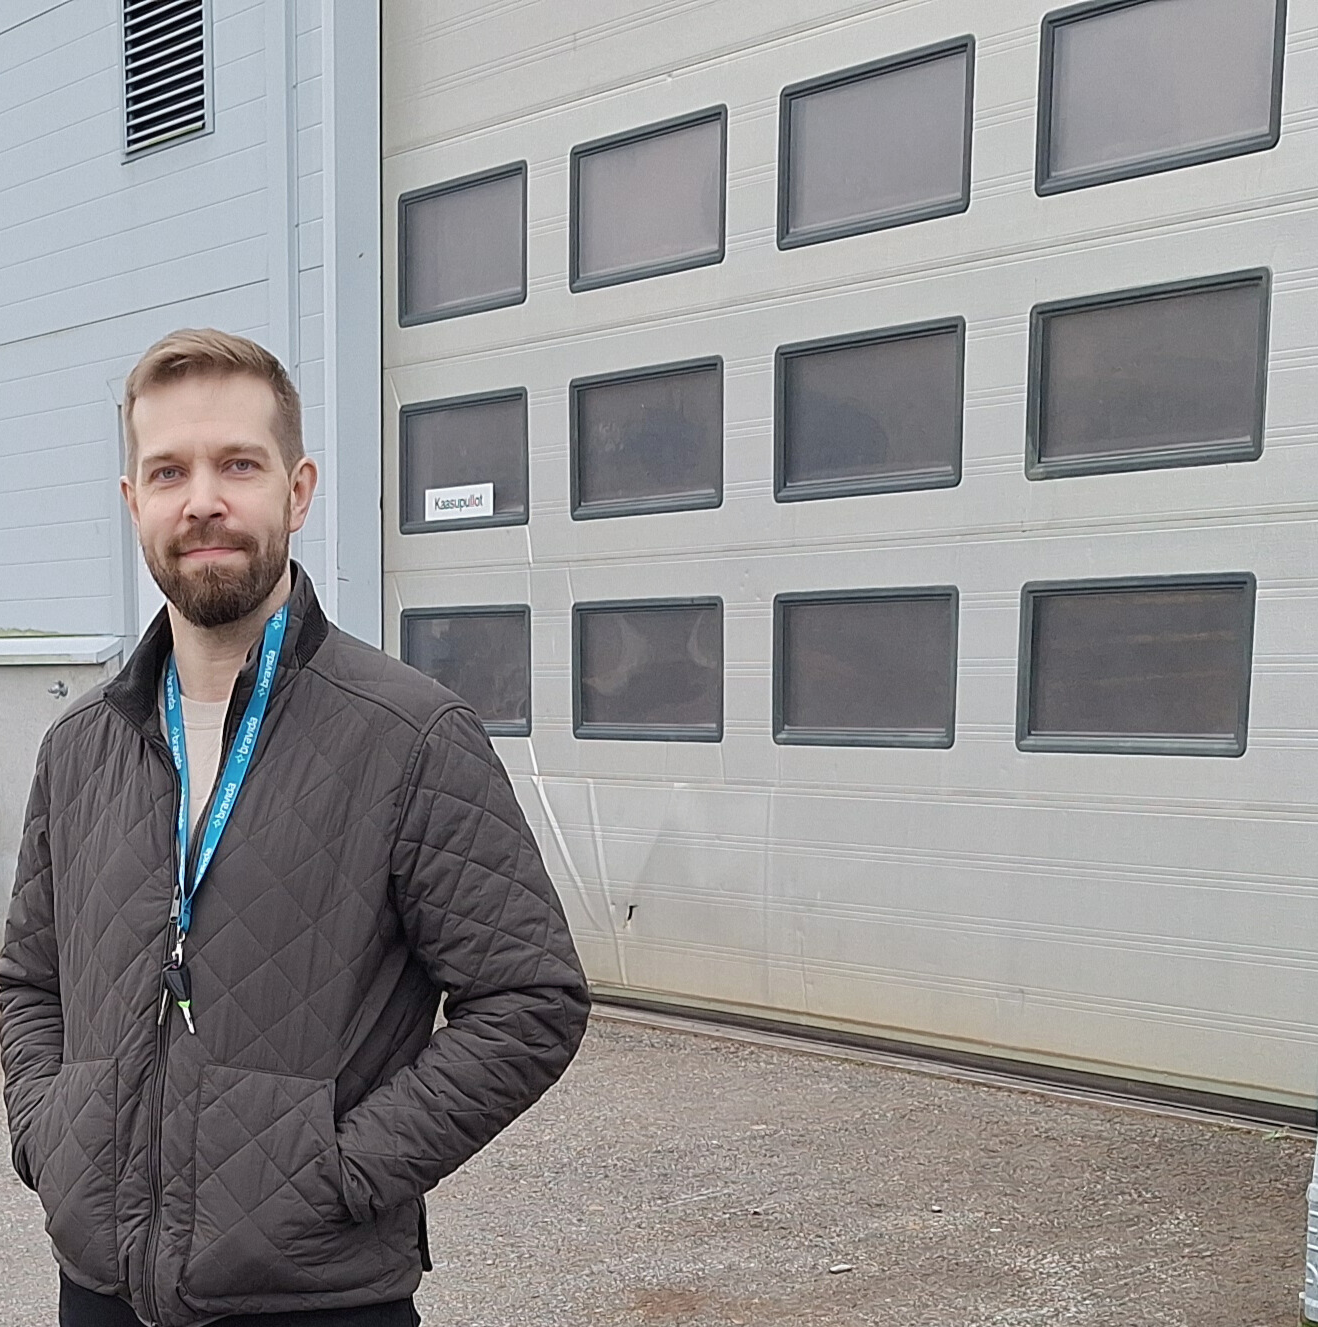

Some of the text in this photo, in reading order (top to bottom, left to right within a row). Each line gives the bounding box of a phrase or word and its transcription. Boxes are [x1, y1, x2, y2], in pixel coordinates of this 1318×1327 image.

[434, 495, 484, 512] Kaasupullot
[259, 650, 276, 688] bravida
[242, 716, 258, 755] bravida
[215, 782, 237, 820] bravida
